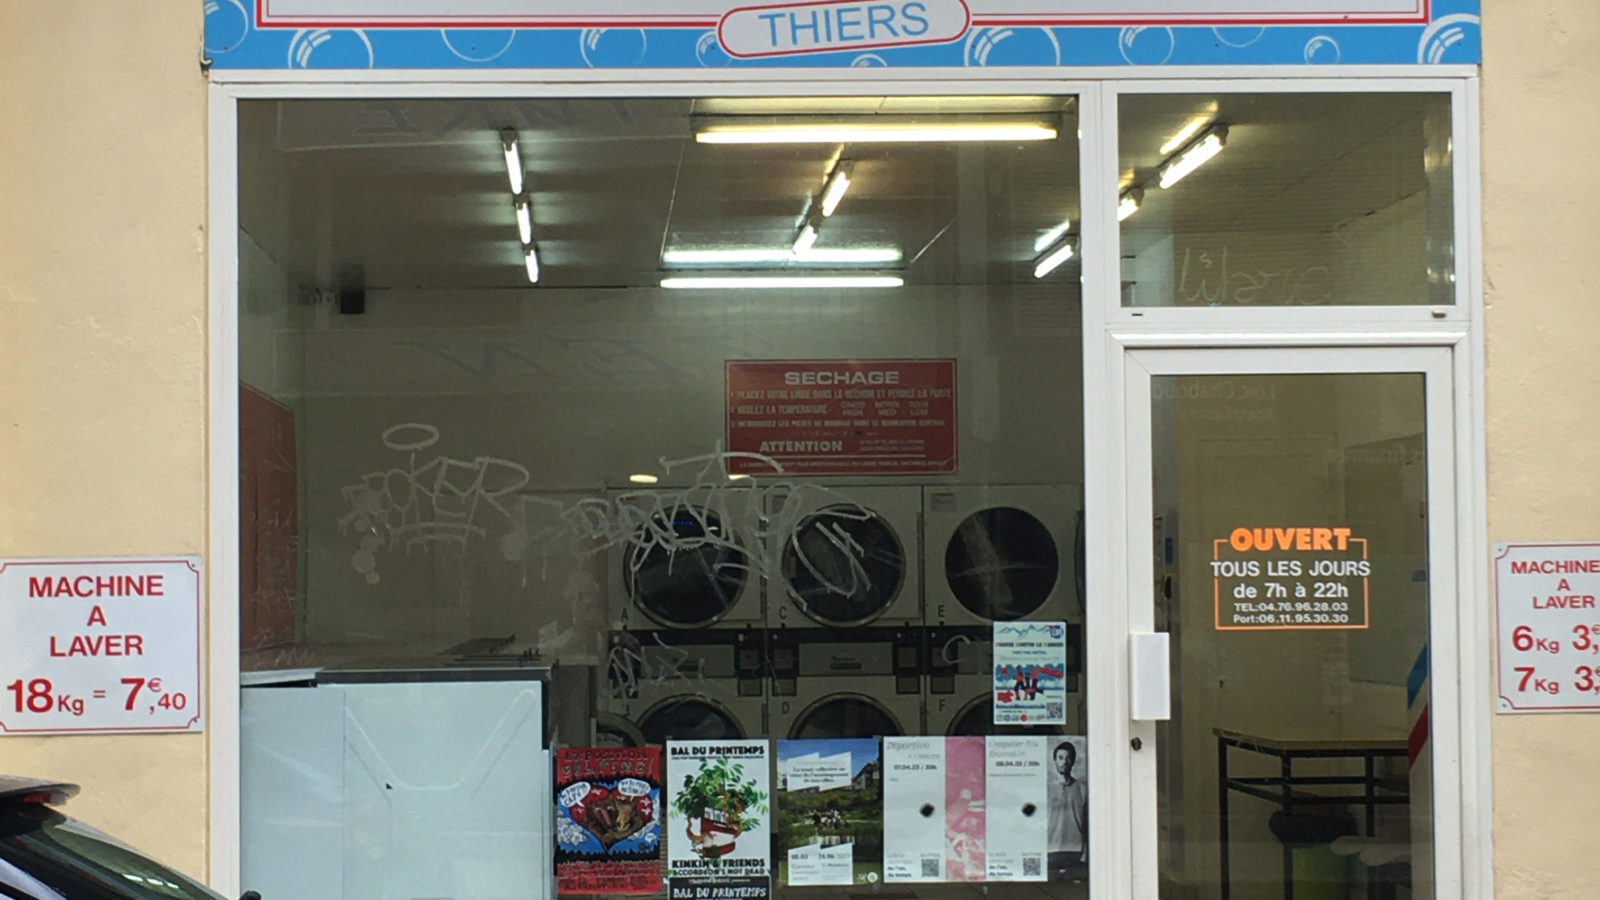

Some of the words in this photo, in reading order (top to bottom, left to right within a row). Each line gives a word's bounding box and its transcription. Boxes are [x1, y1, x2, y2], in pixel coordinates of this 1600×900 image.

[758, 2, 929, 47] THIERS
[784, 371, 899, 385] SECHAGE
[760, 441, 843, 452] ATTENTION
[1230, 527, 1351, 552] OUVERT
[1210, 561, 1260, 577] TOUS
[1267, 561, 1302, 576] LES
[1309, 561, 1371, 576] JOURS
[1511, 560, 1600, 574] MACHINE
[29, 575, 164, 598] MACHINE
[1233, 583, 1257, 598] de
[1264, 583, 1287, 598] 7h
[1295, 582, 1306, 598] à
[1314, 582, 1348, 598] 22h
[1557, 578, 1571, 591] A
[1532, 595, 1595, 609] LAVER
[86, 605, 107, 626] A
[779, 606, 788, 619] C
[937, 605, 945, 617] E
[50, 635, 143, 657] LAVER
[782, 701, 790, 714] D
[938, 700, 946, 711] F
[671, 747, 690, 755] BAL
[692, 746, 707, 755] DU
[709, 746, 764, 755] PRINTEMPS
[723, 859, 765, 868] FRIENDS
[673, 888, 693, 898] BAL
[696, 887, 710, 898] DU
[712, 887, 767, 898] PRINTEMPS
